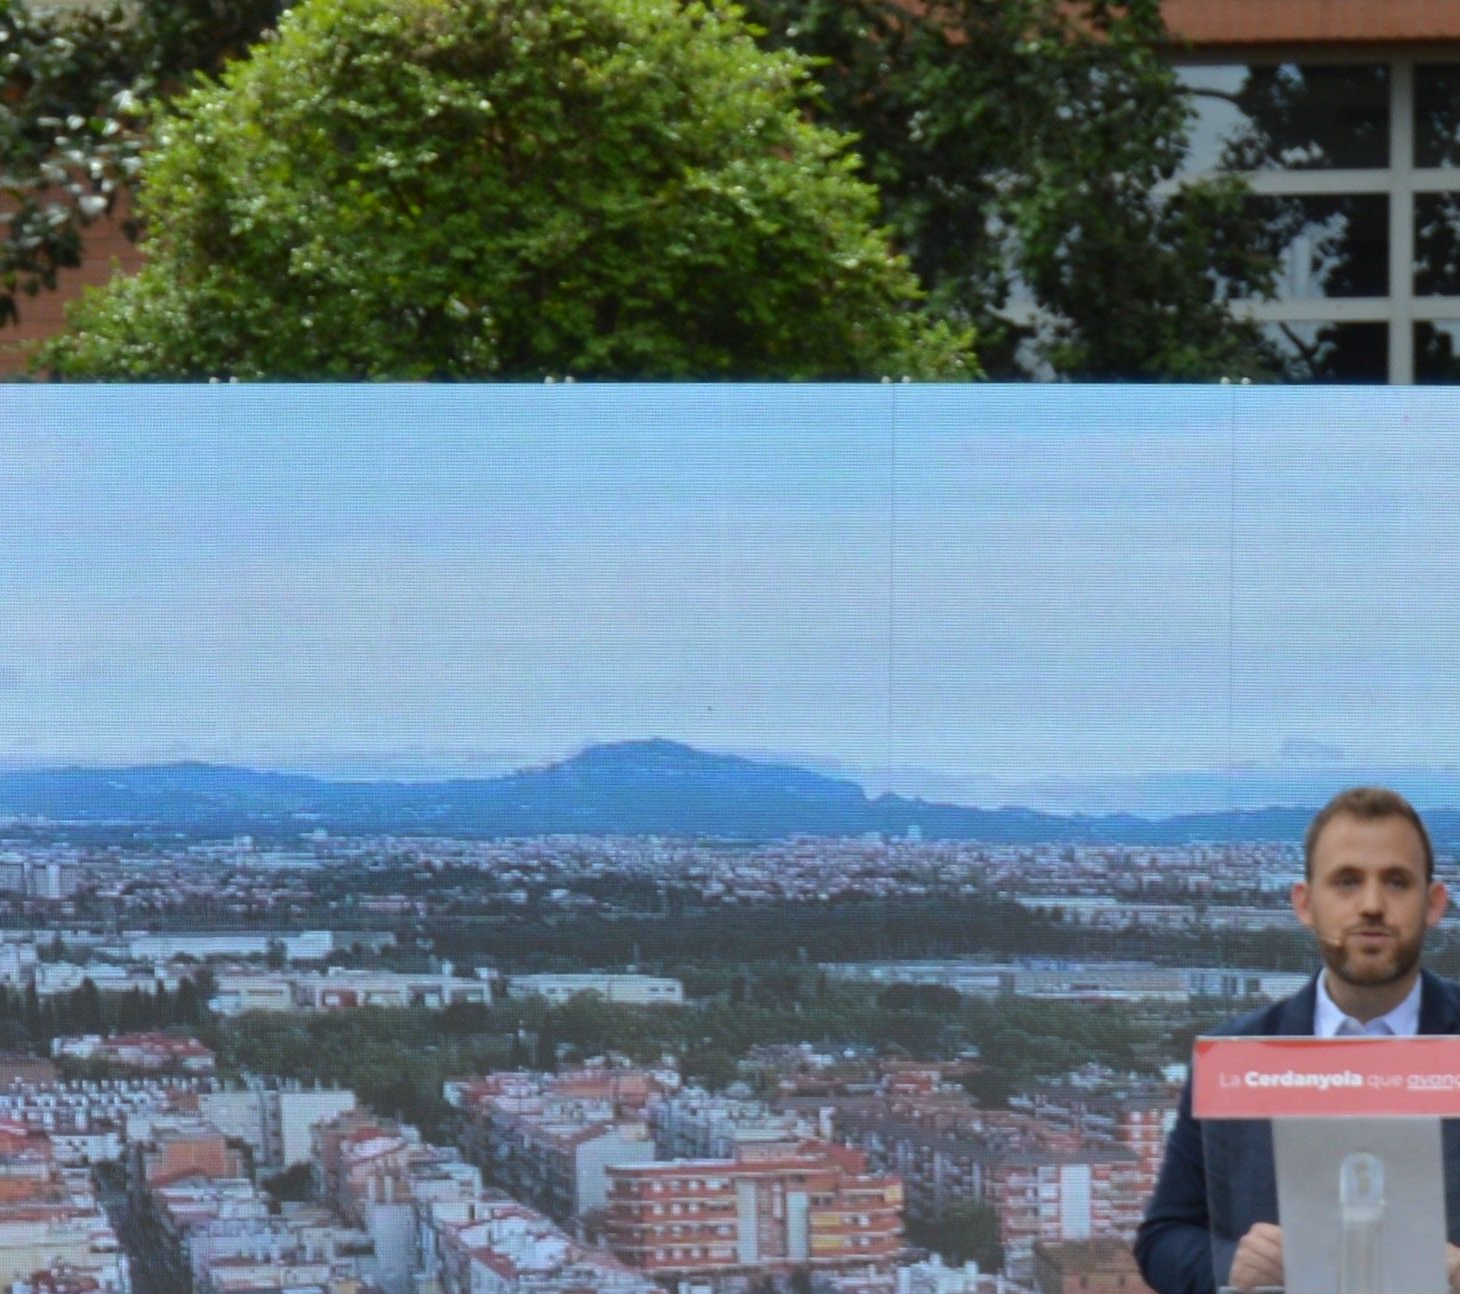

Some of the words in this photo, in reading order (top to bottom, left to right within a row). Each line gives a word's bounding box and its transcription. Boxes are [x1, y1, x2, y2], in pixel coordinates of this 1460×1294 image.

[1219, 1072, 1240, 1088] La
[1244, 1069, 1363, 1091] Cerdanyola
[1367, 1073, 1402, 1090] que
